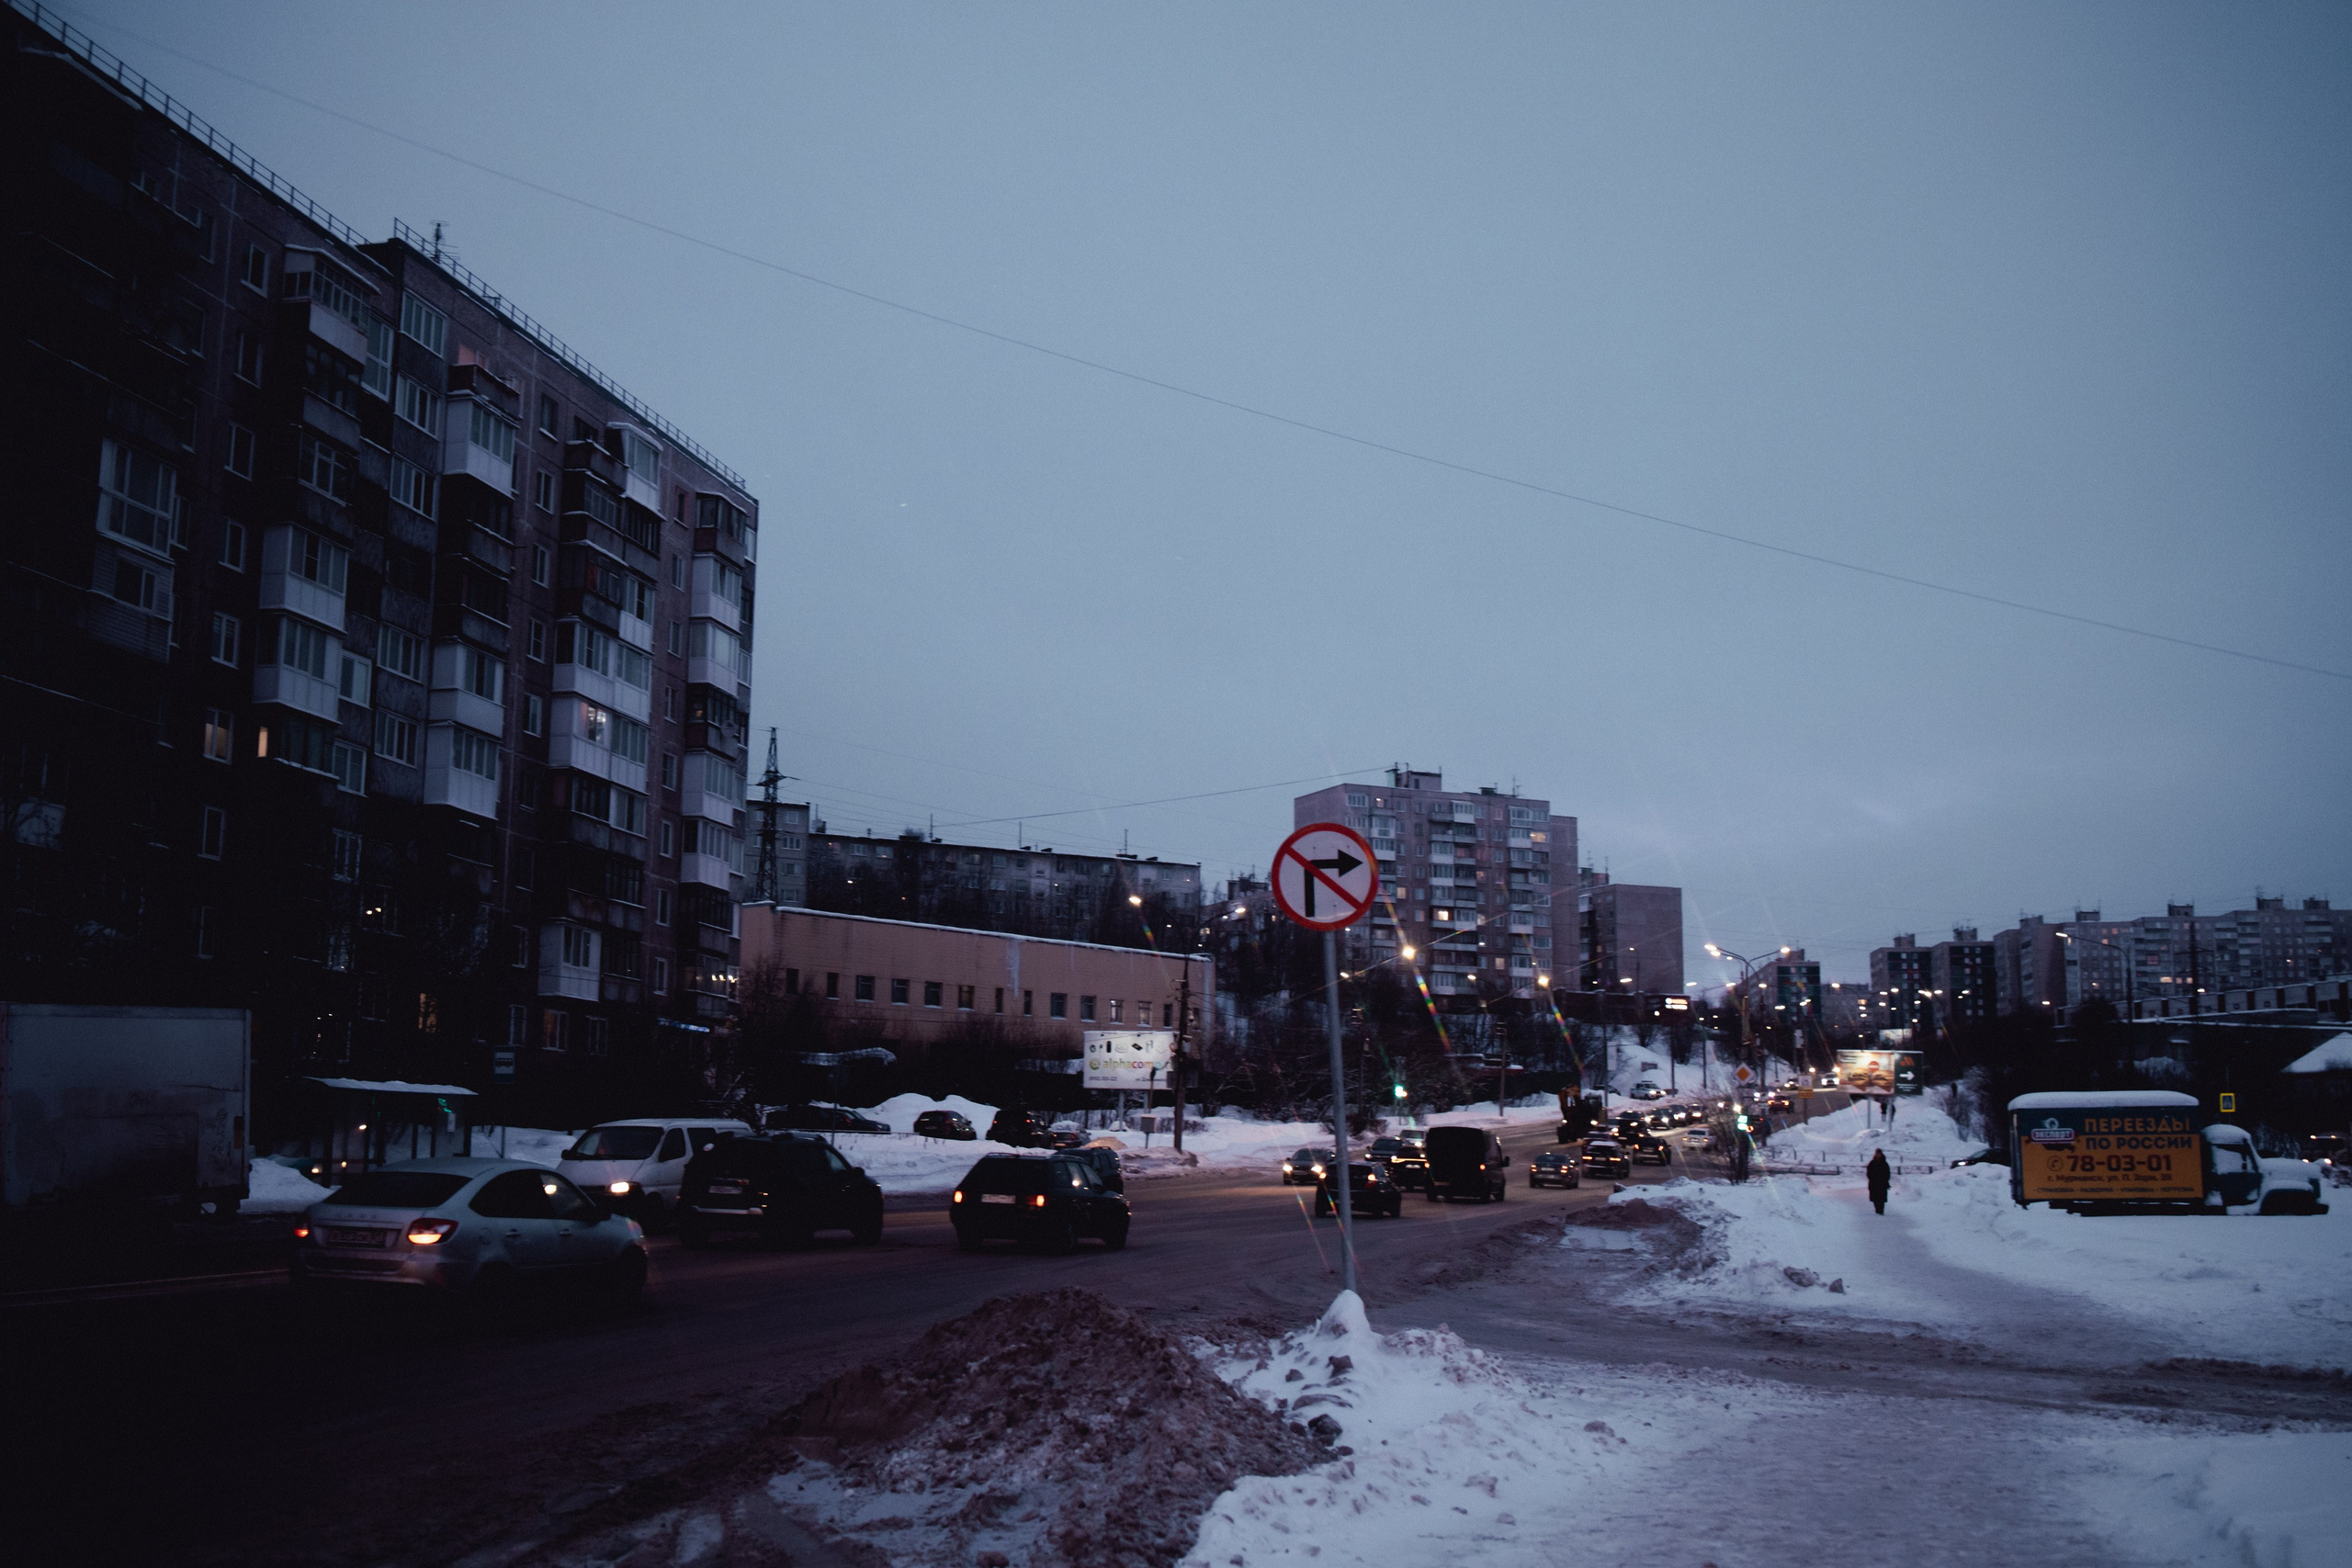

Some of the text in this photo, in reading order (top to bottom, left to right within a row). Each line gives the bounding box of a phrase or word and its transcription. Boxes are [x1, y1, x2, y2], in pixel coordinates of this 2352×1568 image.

[2085, 1117, 2190, 1133] ПЕРЕЕЗДЫ
[2086, 1136, 2192, 1149] ПО РОССИИ
[2066, 1154, 2172, 1172] 78-03-01
